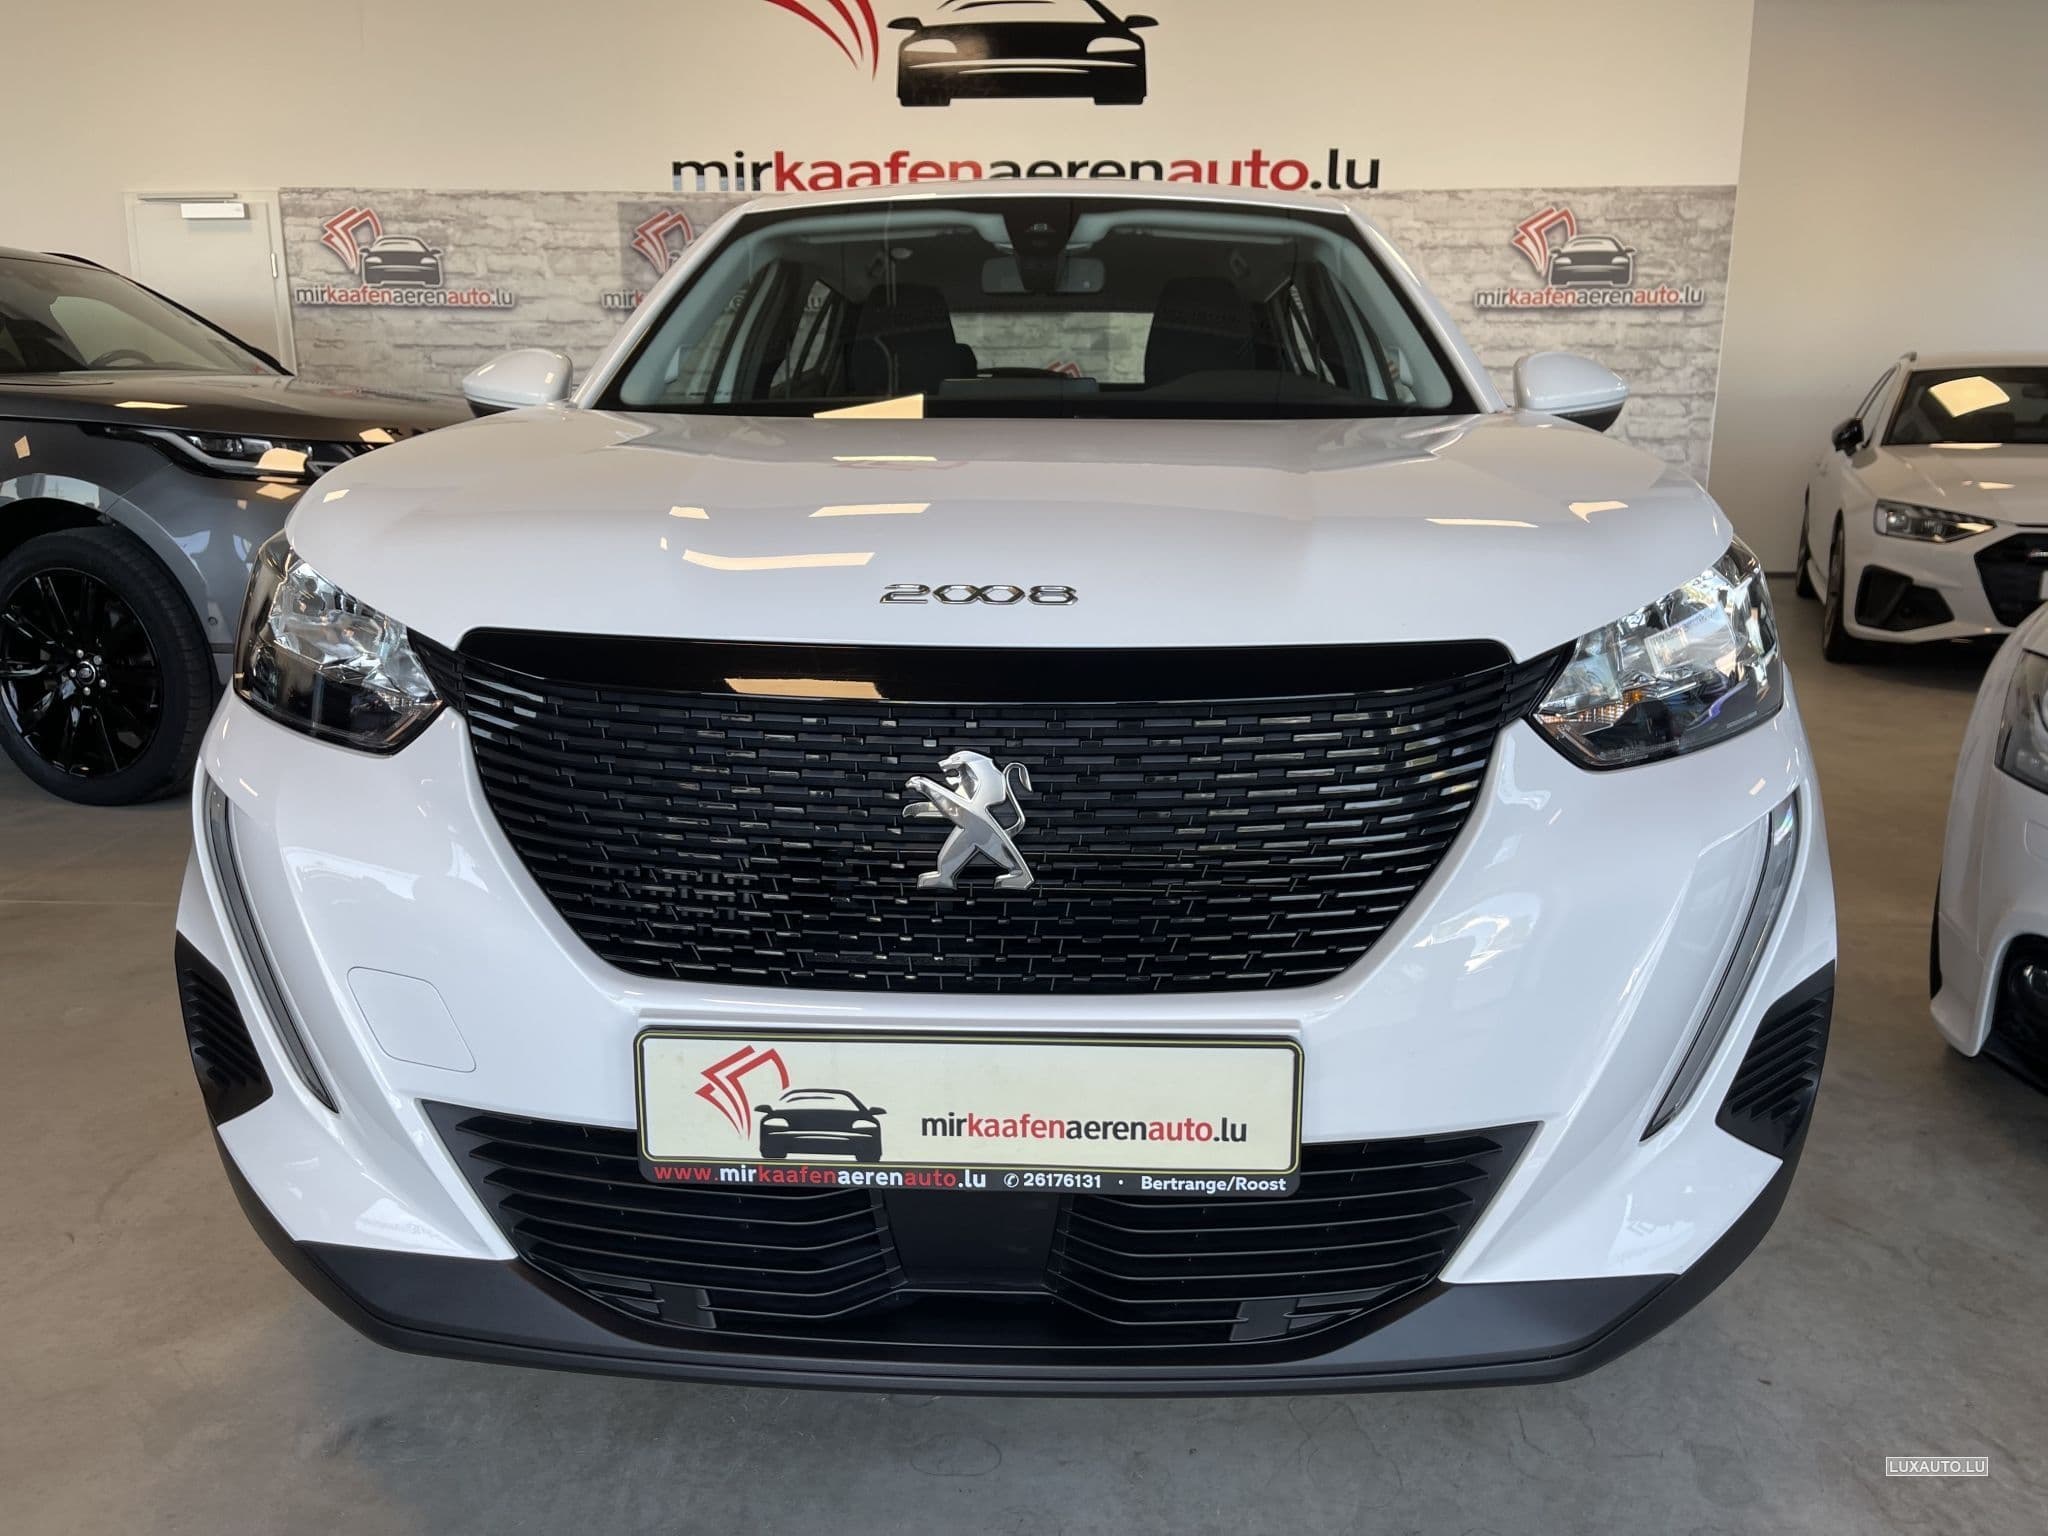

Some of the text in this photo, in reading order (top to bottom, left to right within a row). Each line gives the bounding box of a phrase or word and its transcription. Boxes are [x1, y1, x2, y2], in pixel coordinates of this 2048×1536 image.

[296, 286, 513, 306] mirkaafenaerenauto.lu
[1476, 285, 1703, 306] mirkaafenaerenauto.lu
[880, 583, 1079, 605] 2008
[921, 1112, 1247, 1143] mirkaafenaerenauto.lu
[653, 1164, 1287, 1193] www.mirkaafenaerenauto.lu 26176131 Bertrange/Roost
